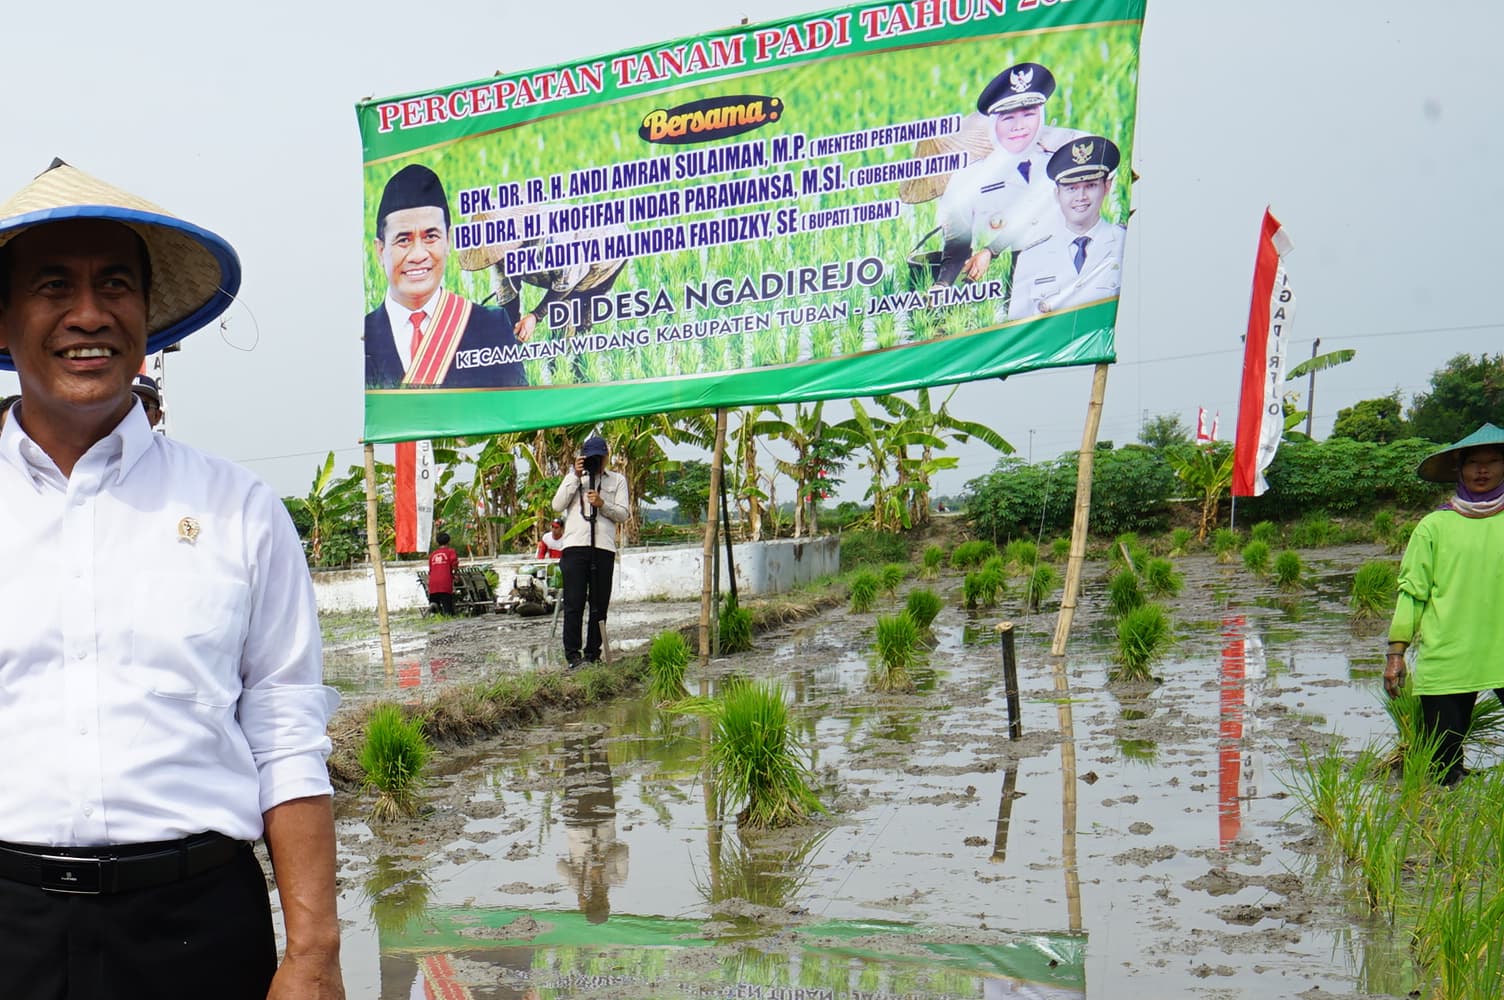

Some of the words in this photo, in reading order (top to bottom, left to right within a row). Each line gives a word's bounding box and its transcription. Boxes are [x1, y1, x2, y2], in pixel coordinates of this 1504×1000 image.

[378, 63, 603, 132] PERCEPATAN
[612, 36, 744, 87] TANAM
[755, 15, 850, 60] PADI
[861, 0, 1005, 39] TAHUN
[455, 224, 482, 250] IBU
[485, 217, 521, 245] DRA.
[524, 213, 545, 239] HJ.
[548, 200, 625, 235] KHOFIFAH
[629, 191, 681, 222] INDAR
[684, 172, 798, 214] PARAWANSA,
[802, 164, 846, 196] M.SI.
[460, 187, 495, 215] BPK.
[499, 183, 524, 209] DR.
[527, 179, 548, 204] IR.
[551, 175, 566, 201] H.
[569, 167, 608, 197] ANDI
[612, 156, 671, 191] AMRAN
[675, 141, 769, 181] SULAIMAN,
[773, 134, 806, 164] M.P.
[871, 119, 937, 146] PERTANIAN
[506, 248, 541, 275] BPK.
[545, 239, 601, 269] ADITYA
[605, 225, 686, 261] HALINDRA
[690, 212, 773, 248] FARIDZKY,
[776, 208, 798, 236] SE
[456, 339, 565, 368] KECAMATAN
[572, 327, 650, 354] WIDANG
[656, 313, 770, 343] KABUPATEN
[776, 302, 847, 327] TUBAN
[867, 294, 926, 316] JAWA
[929, 281, 1003, 307] TIMUR
[549, 298, 582, 329] DI
[592, 287, 675, 324] DESA
[685, 256, 884, 311] NGADIREJO
